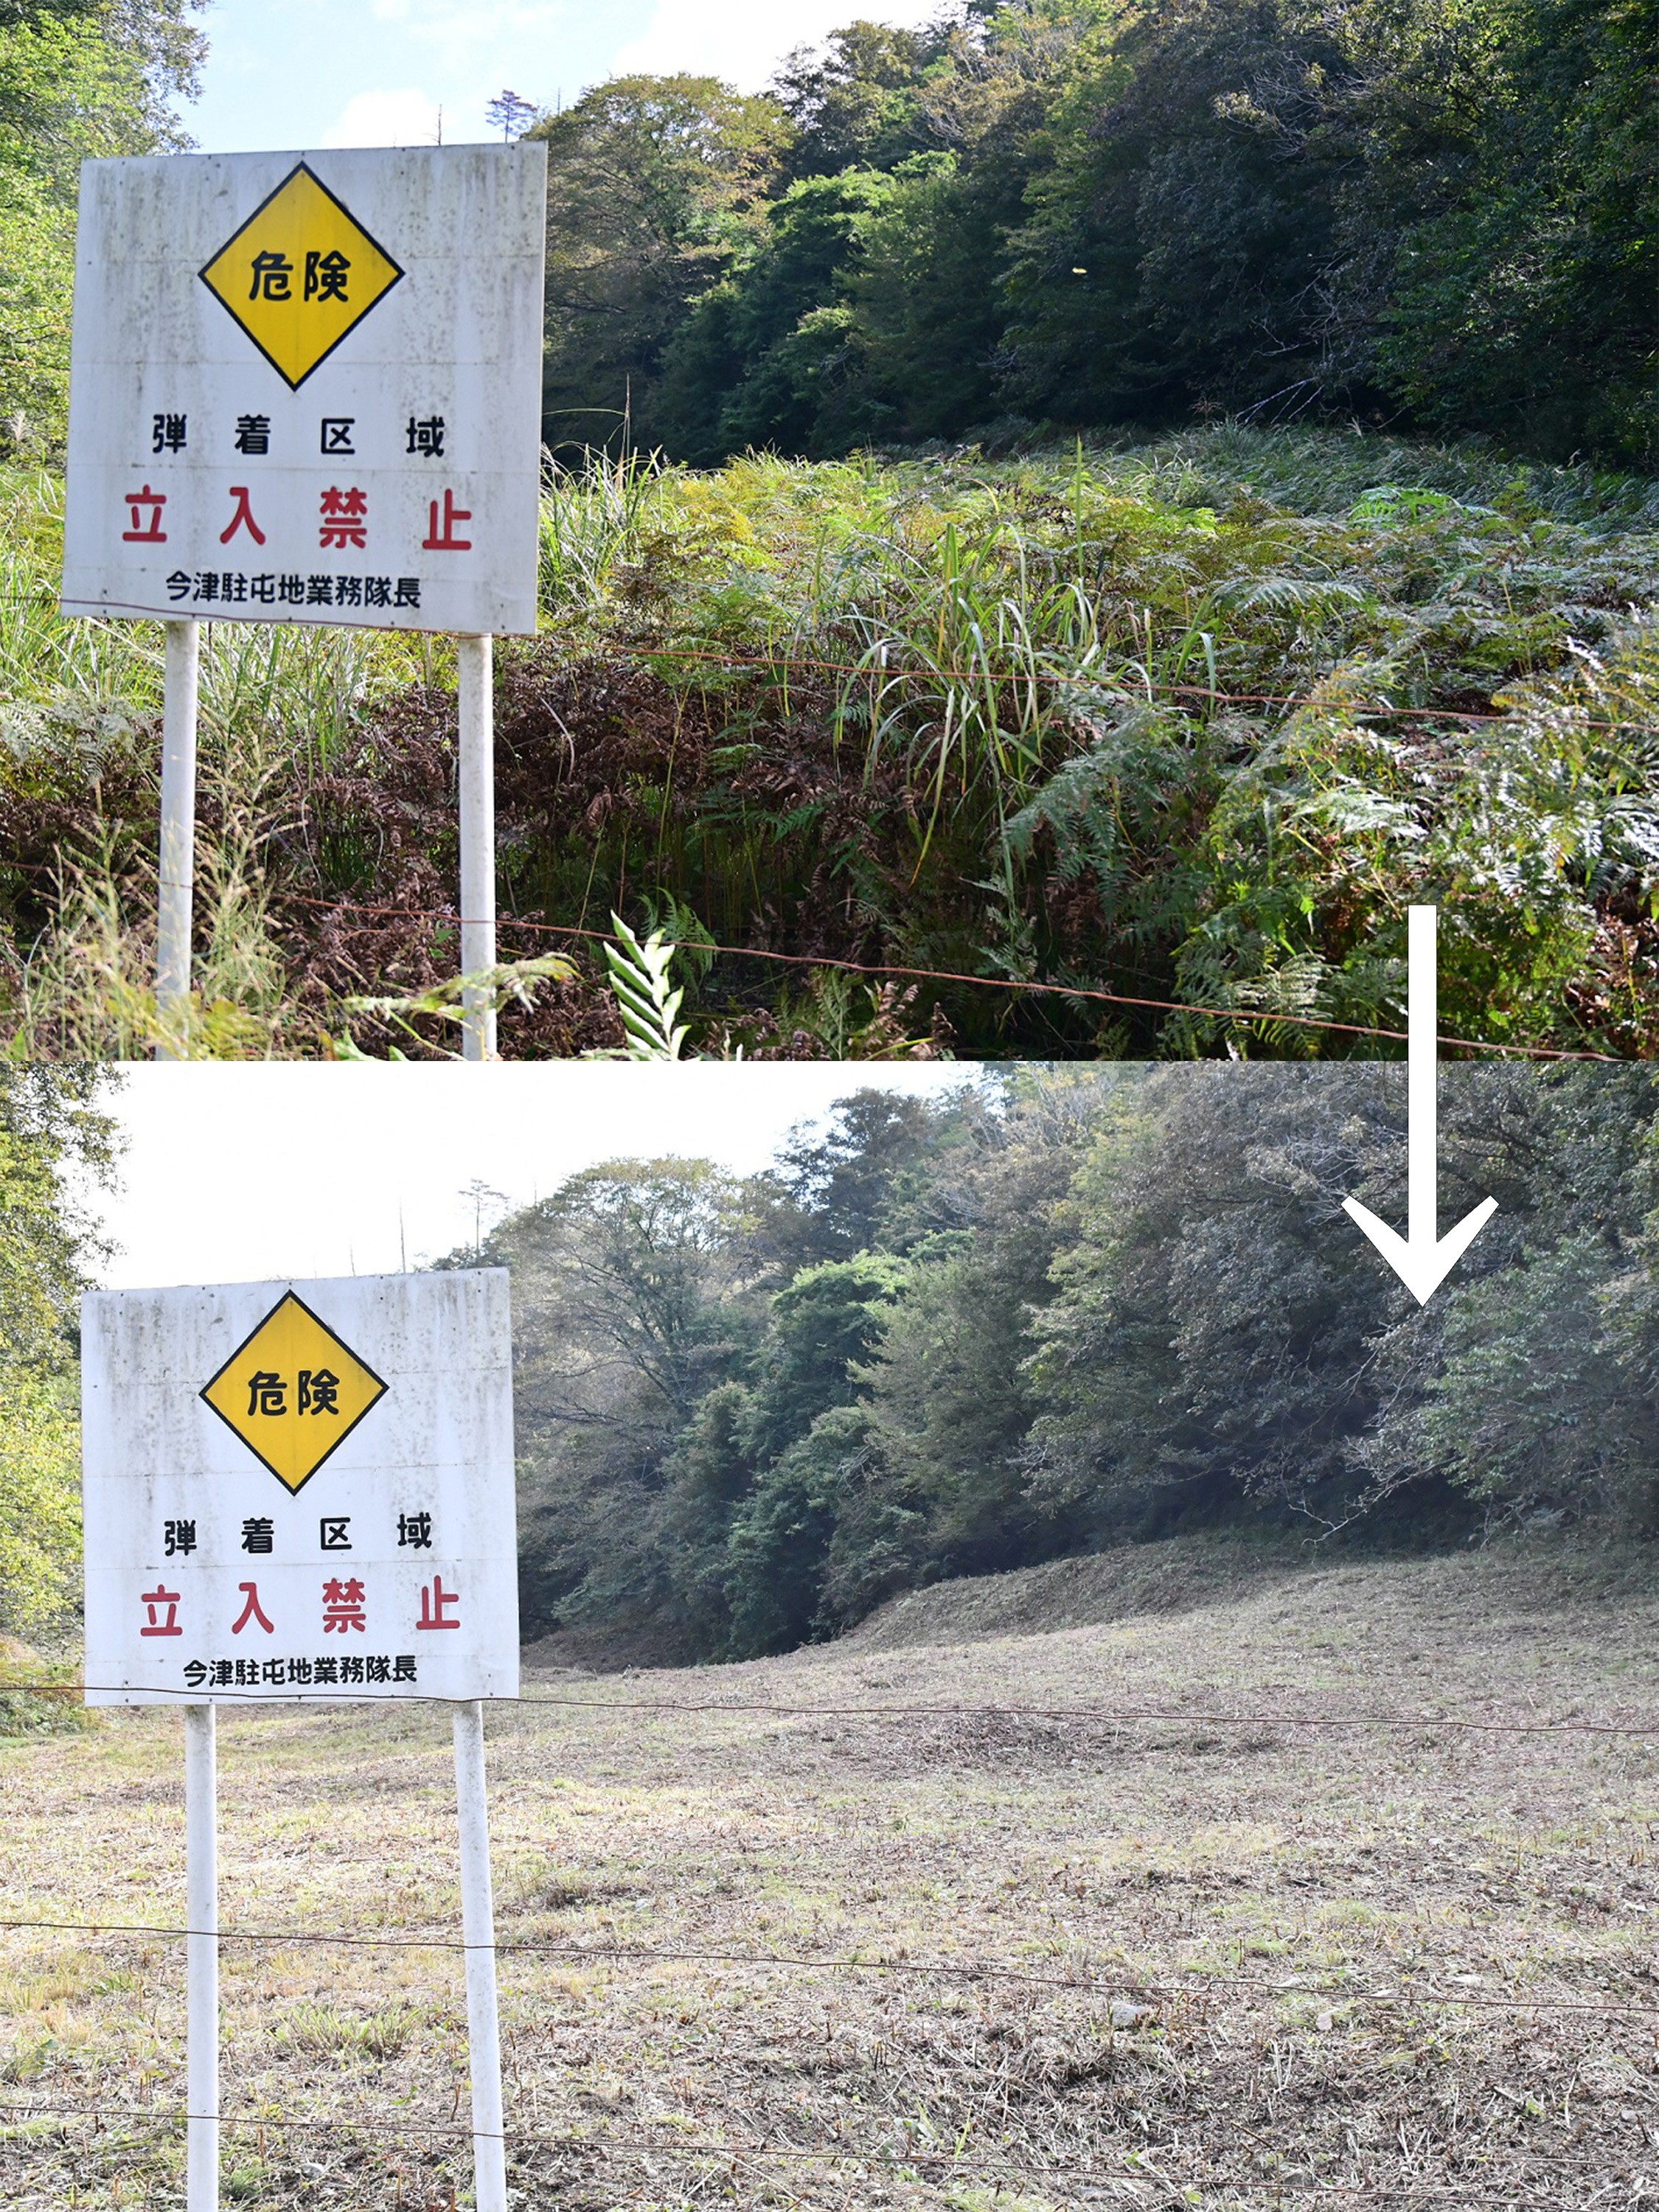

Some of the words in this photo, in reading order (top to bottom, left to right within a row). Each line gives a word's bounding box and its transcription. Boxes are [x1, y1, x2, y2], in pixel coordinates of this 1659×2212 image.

[249, 250, 351, 302] 危険
[152, 414, 445, 458] 弾着区域
[122, 484, 472, 551] 立入禁止
[166, 571, 422, 609] 今津駐屯地業務隊長
[247, 1369, 340, 1416] 危険
[164, 1512, 432, 1556] 弾着区域
[140, 1575, 461, 1636] 立入禁止
[183, 1655, 417, 1688] 今津駐屯地業務隊長
